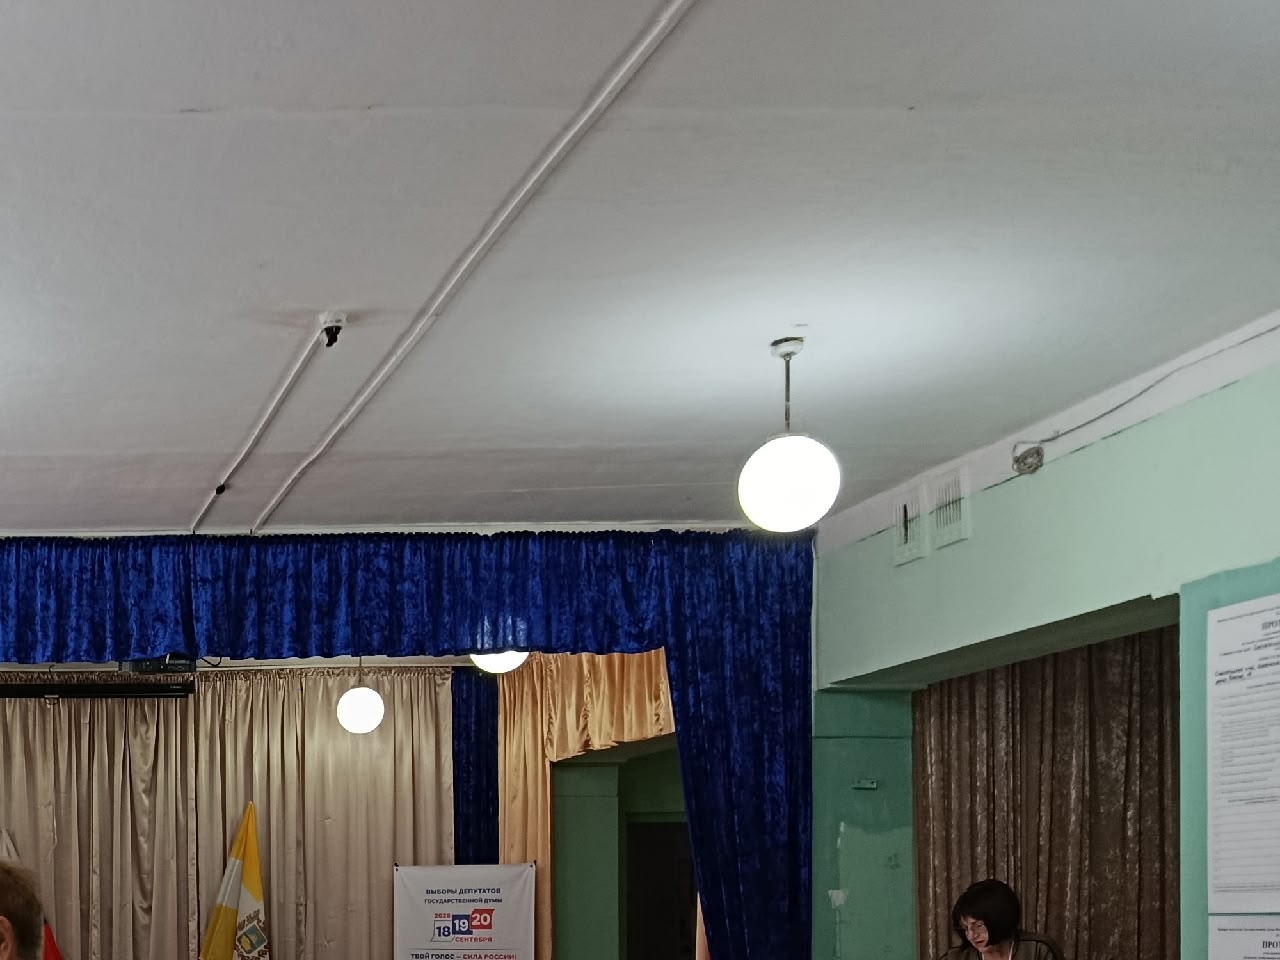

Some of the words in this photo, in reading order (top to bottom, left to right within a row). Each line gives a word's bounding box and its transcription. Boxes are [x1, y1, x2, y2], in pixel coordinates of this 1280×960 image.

[458, 887, 501, 895] ДЕПУТАТОВ
[436, 925, 451, 937] 18
[453, 918, 469, 932] 19
[471, 912, 491, 926] 20
[410, 952, 430, 960] ТВОЙ
